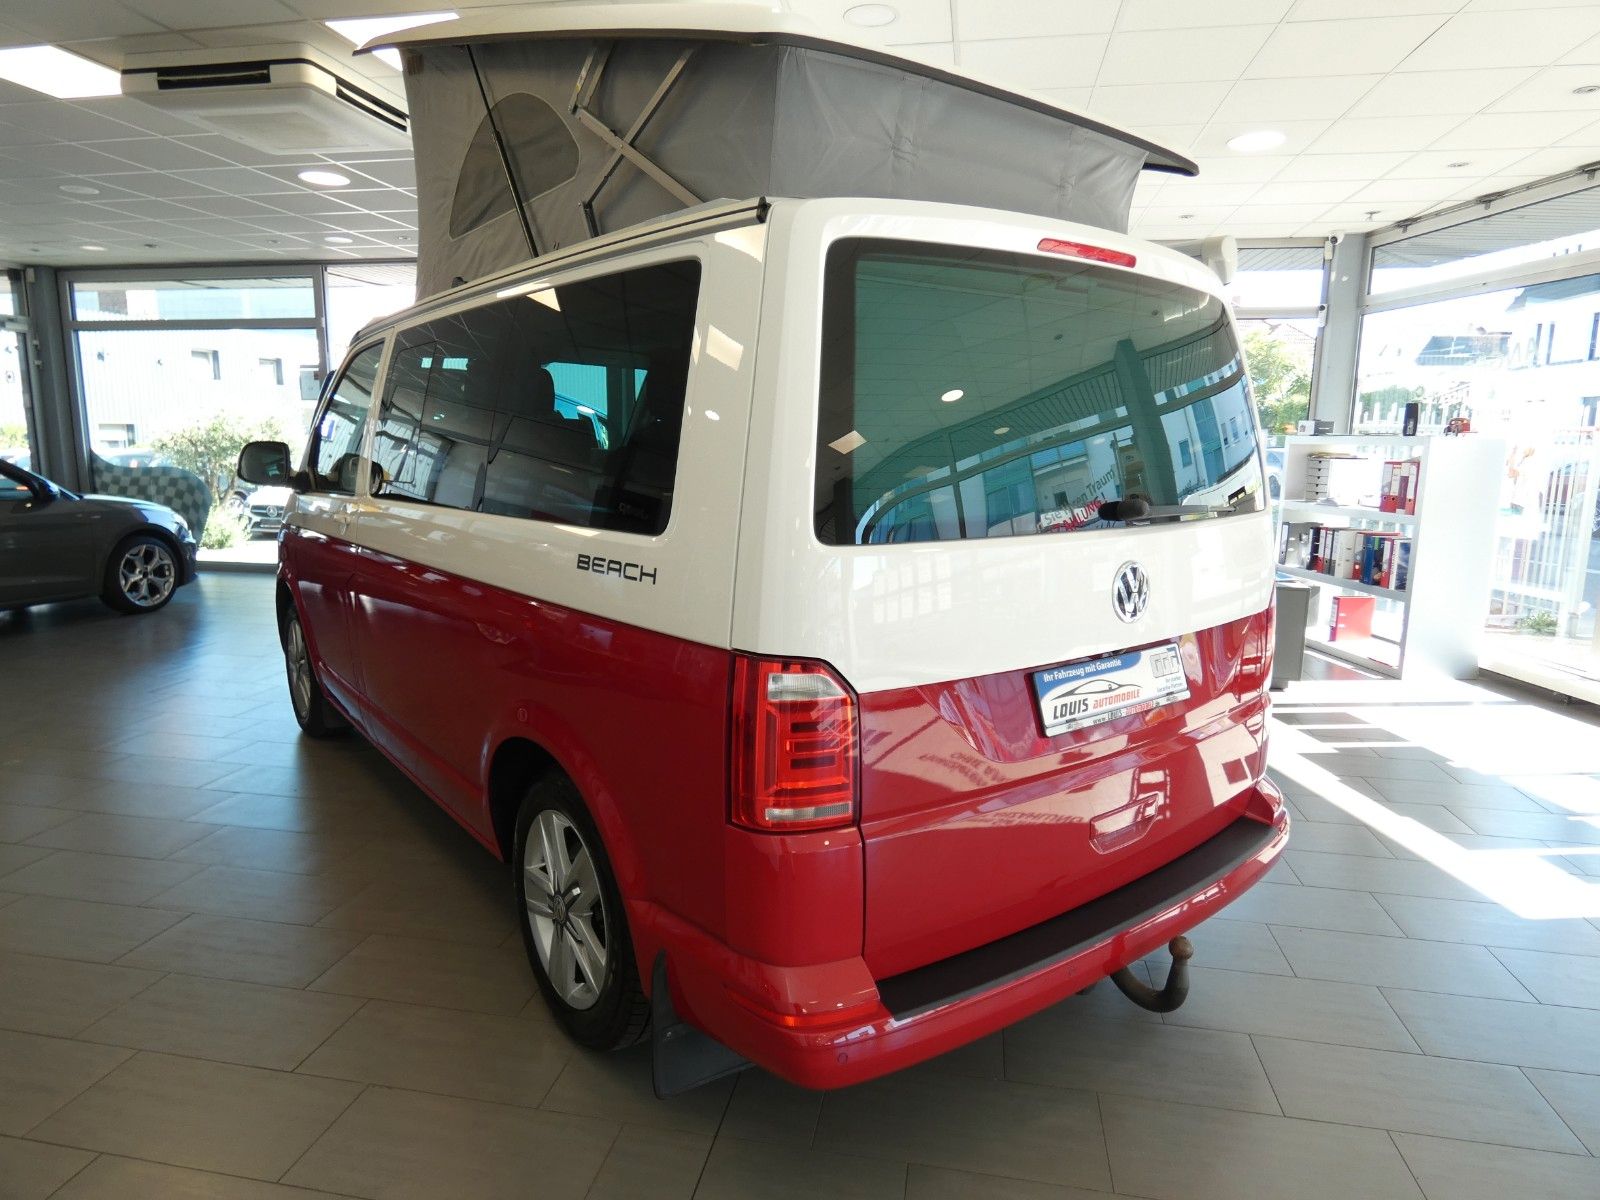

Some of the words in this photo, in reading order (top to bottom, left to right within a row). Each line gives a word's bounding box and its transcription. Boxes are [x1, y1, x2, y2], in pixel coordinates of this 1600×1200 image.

[1085, 468, 1116, 498] Traum
[576, 553, 657, 585] BEACH
[1043, 672, 1055, 682] Ihr
[1054, 666, 1085, 680] Fahrzeug
[1085, 663, 1097, 674] mit
[1096, 658, 1122, 670] Garantie
[1053, 697, 1089, 720] LOUIS
